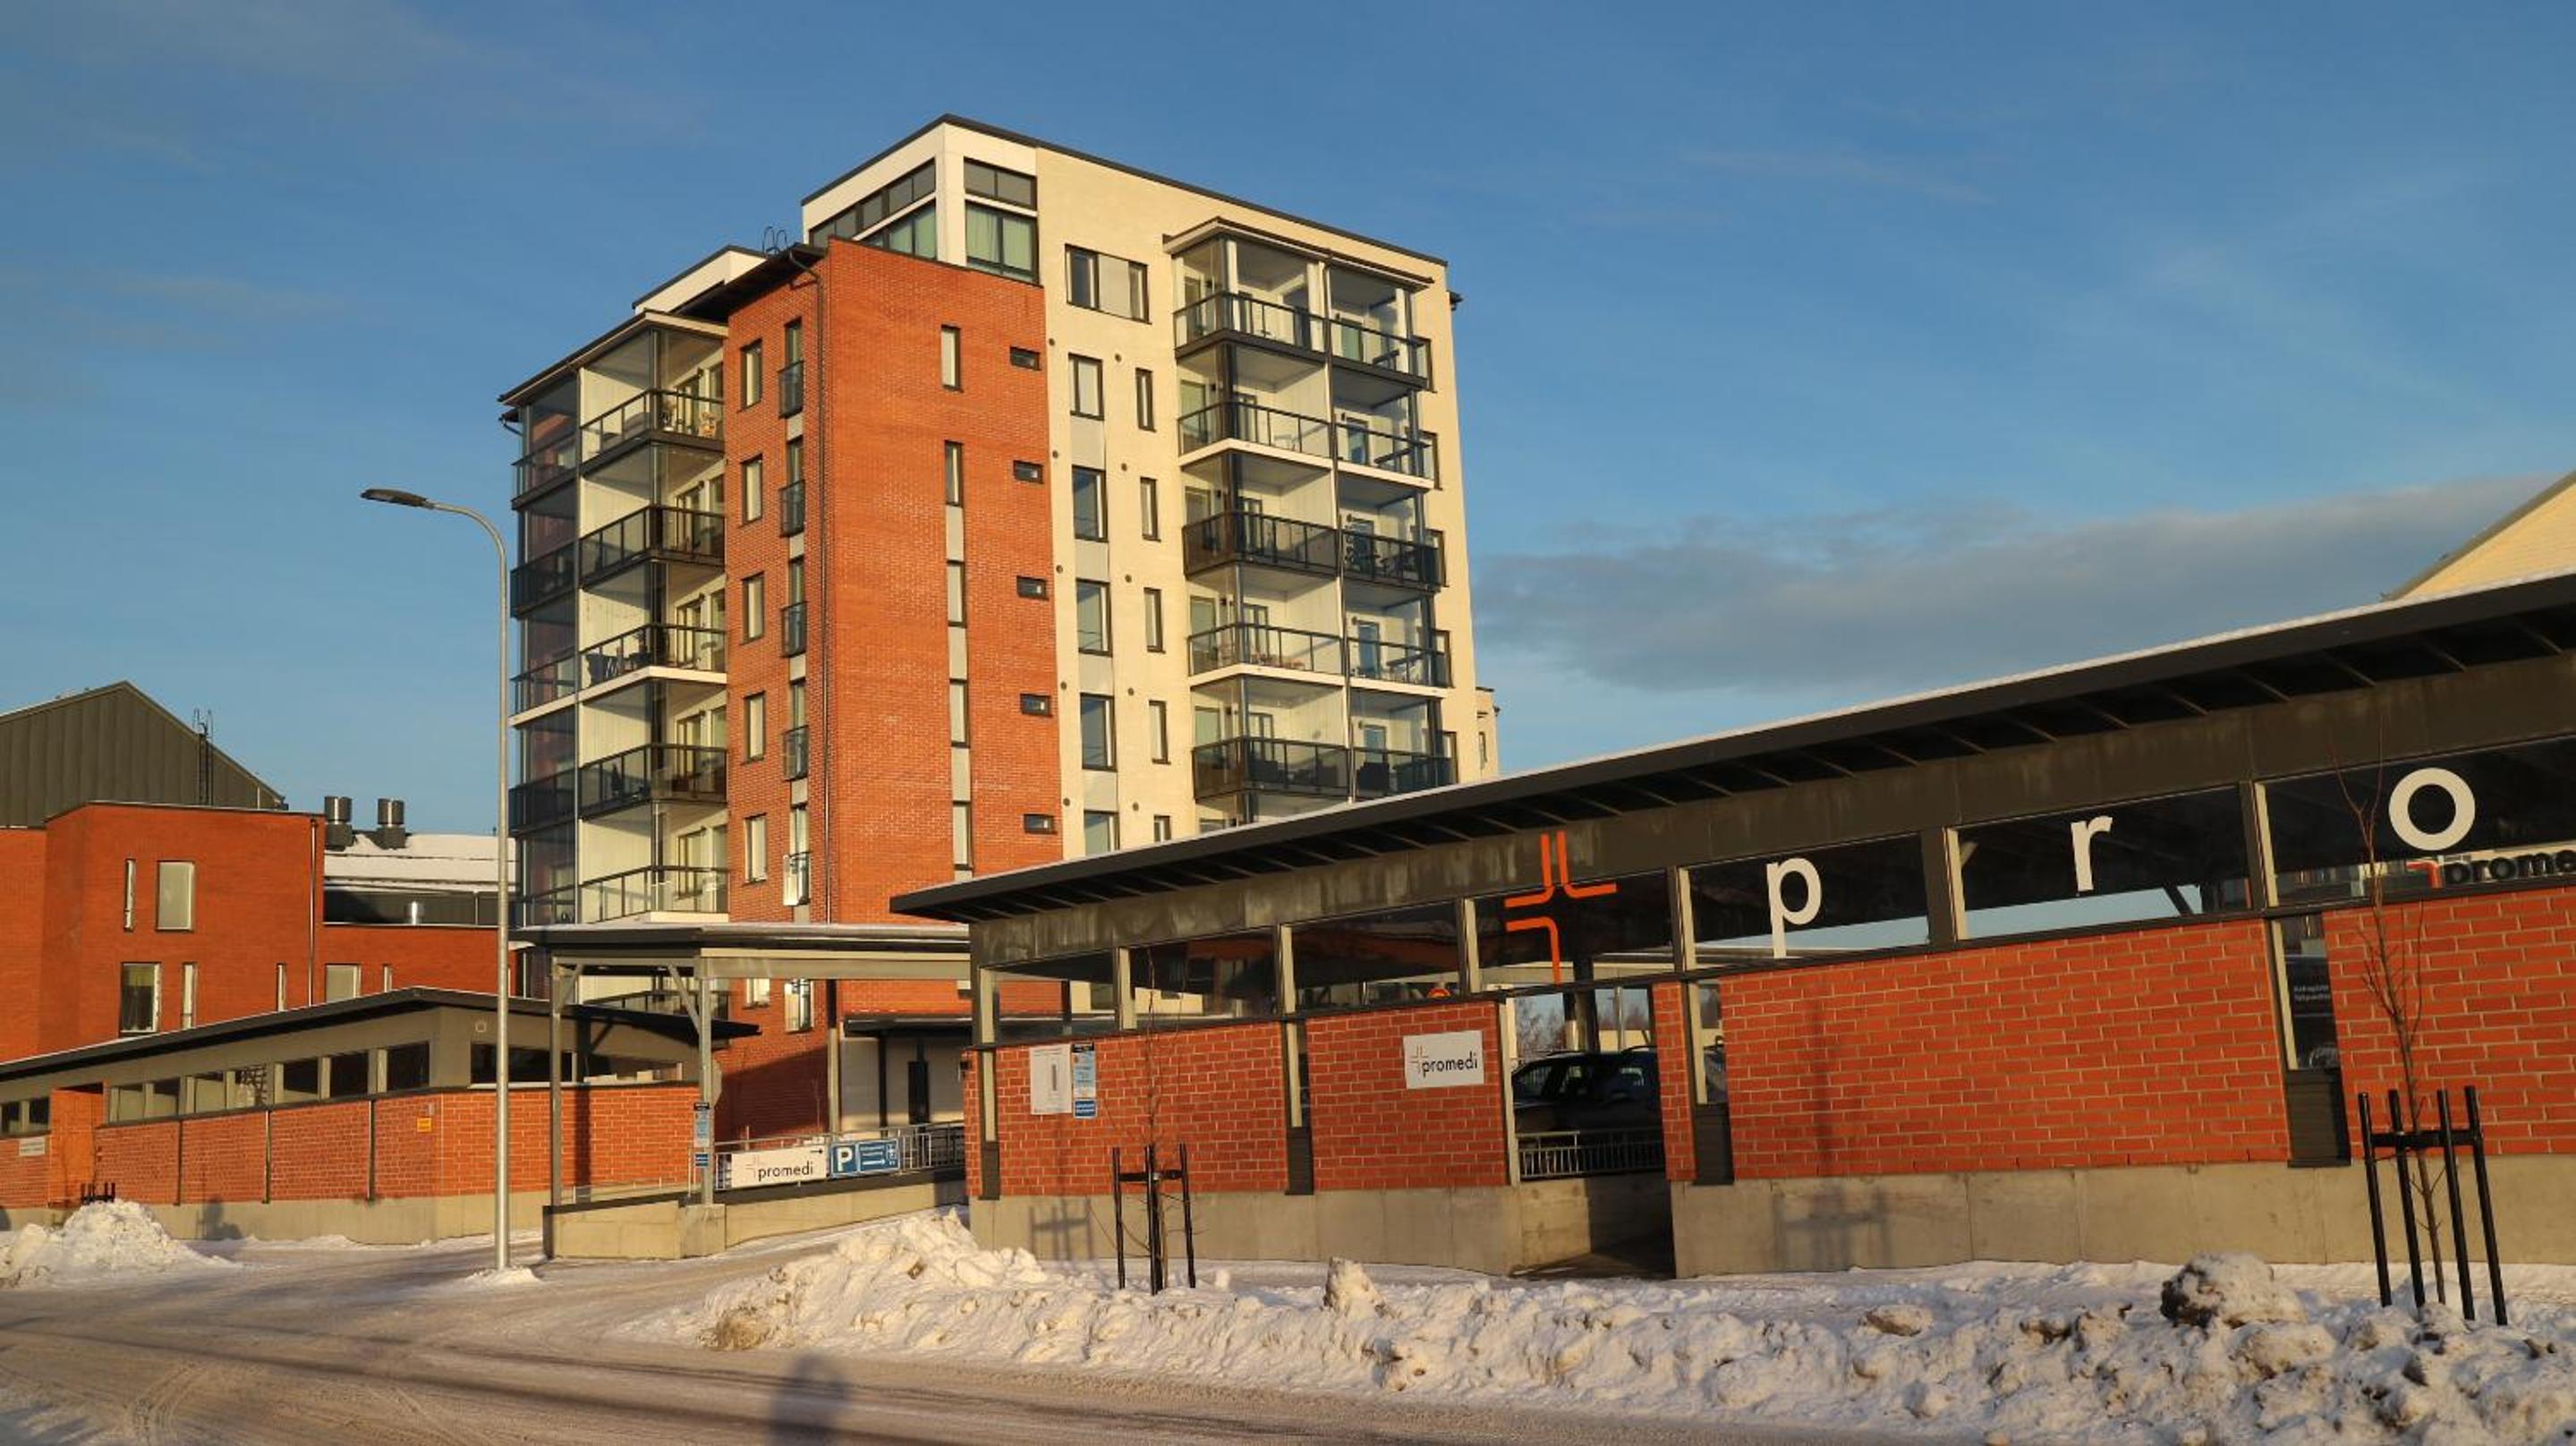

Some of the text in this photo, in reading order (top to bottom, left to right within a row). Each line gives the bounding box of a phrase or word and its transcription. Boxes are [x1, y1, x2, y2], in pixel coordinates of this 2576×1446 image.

[1422, 1050, 1478, 1078] promedi
[758, 1160, 813, 1182] promedi
[837, 1147, 853, 1172] P
